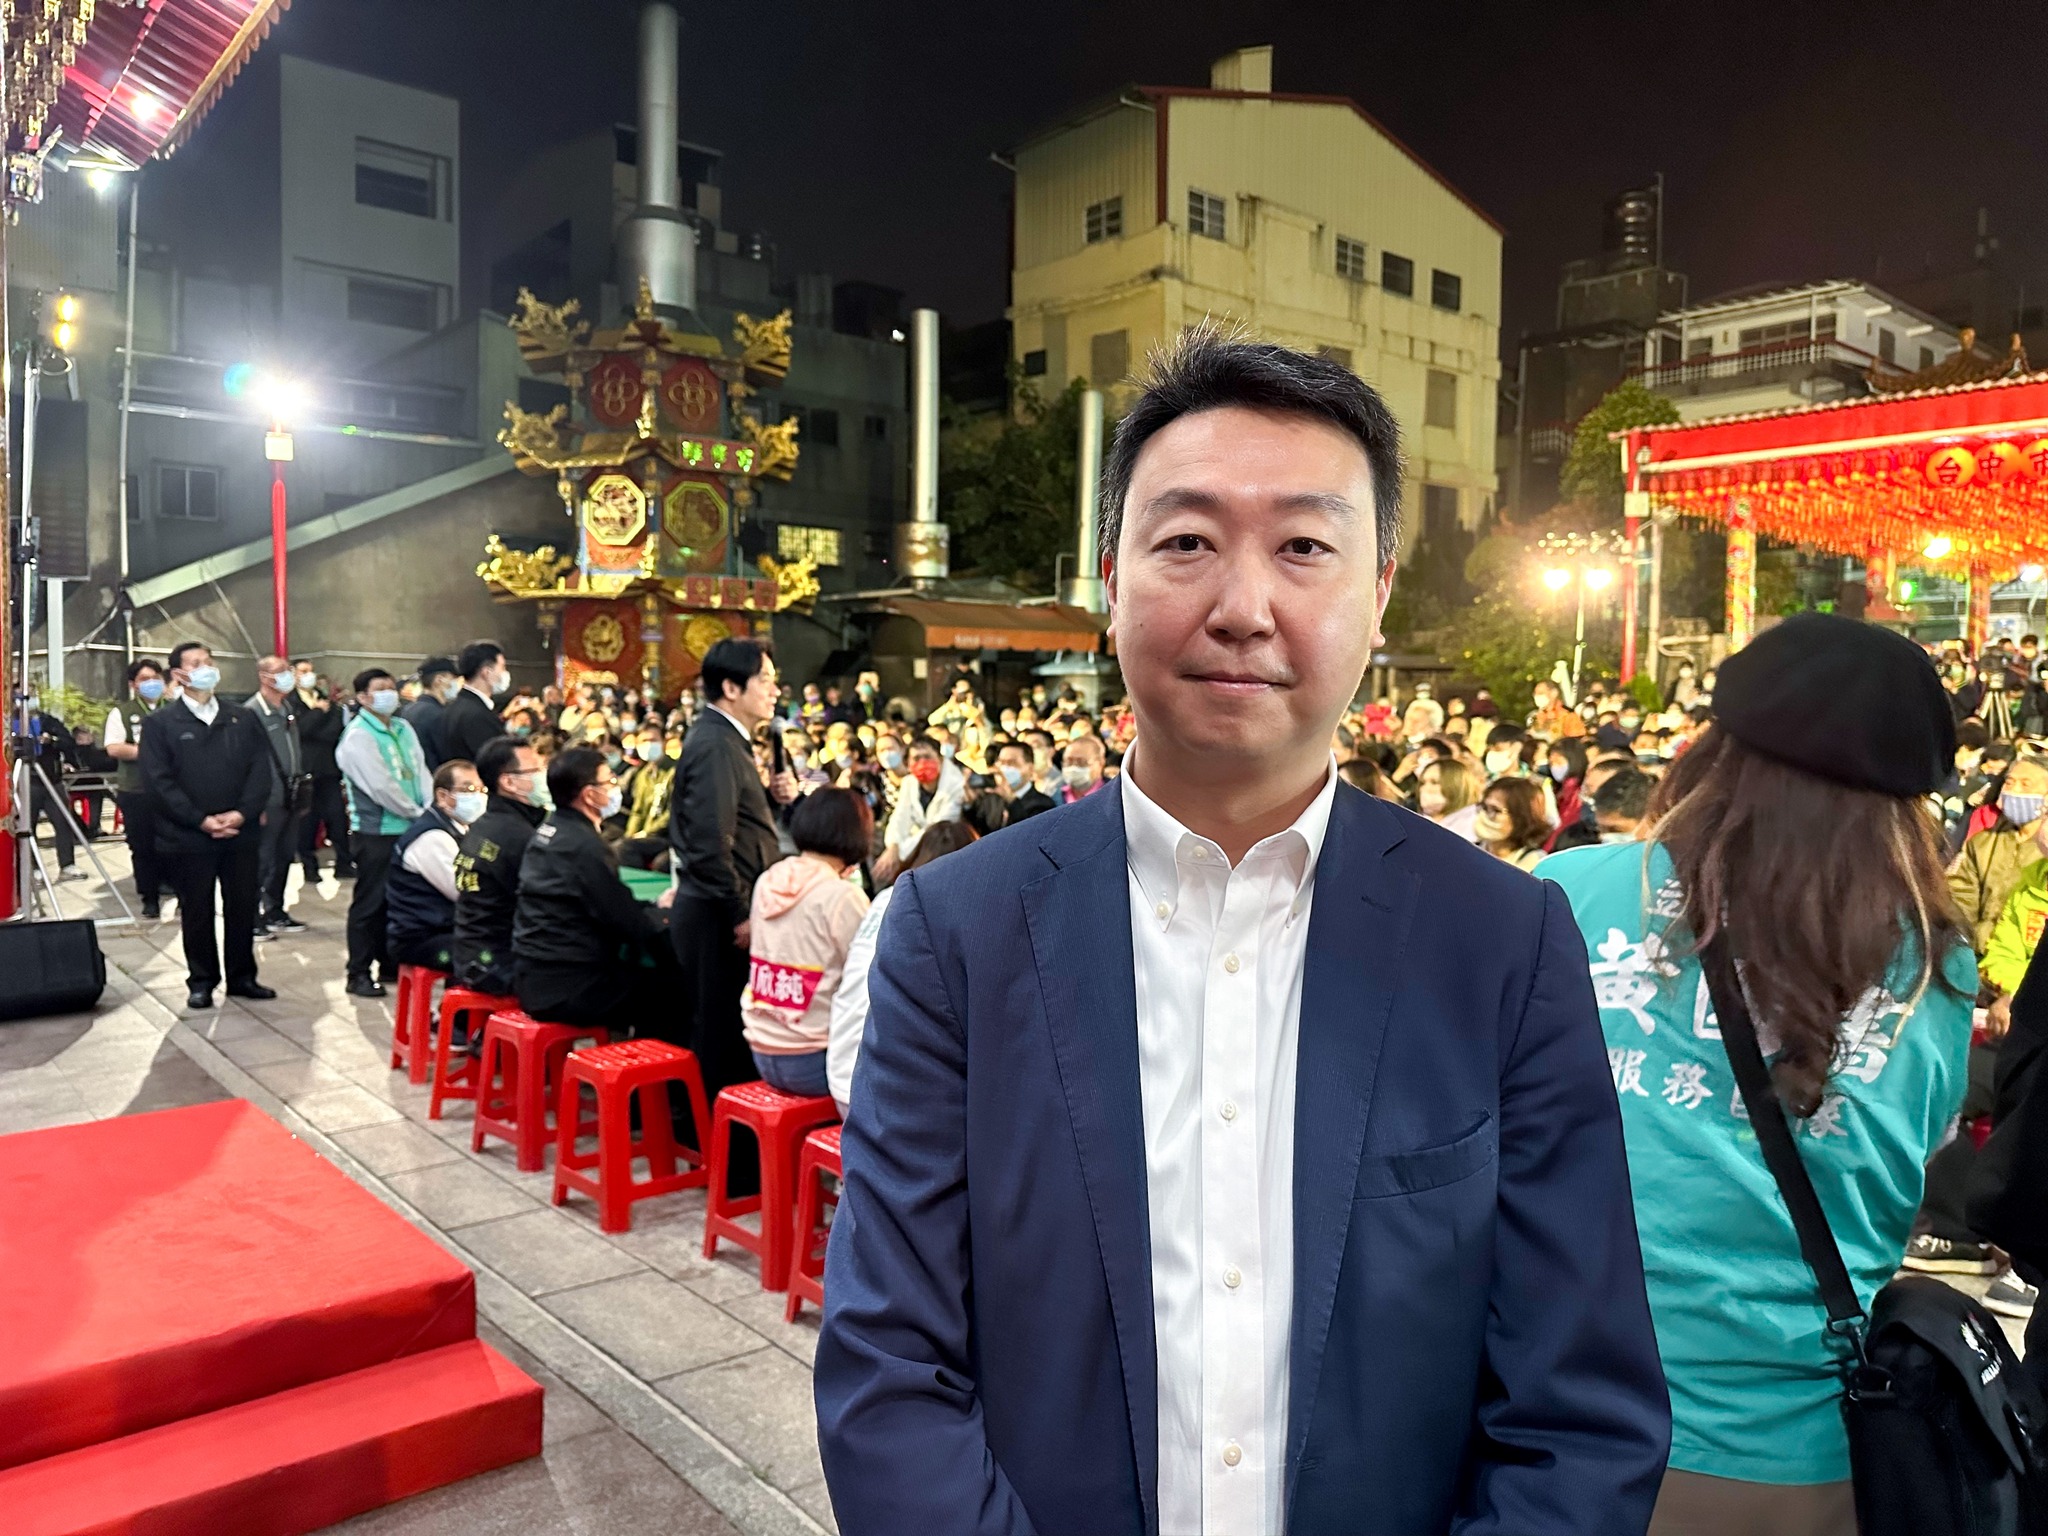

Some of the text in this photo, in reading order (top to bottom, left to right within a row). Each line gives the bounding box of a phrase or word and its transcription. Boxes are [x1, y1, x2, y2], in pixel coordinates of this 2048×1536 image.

[1589, 927, 1915, 1084] 黃書
[1606, 1047, 1848, 1139] 服務隊
